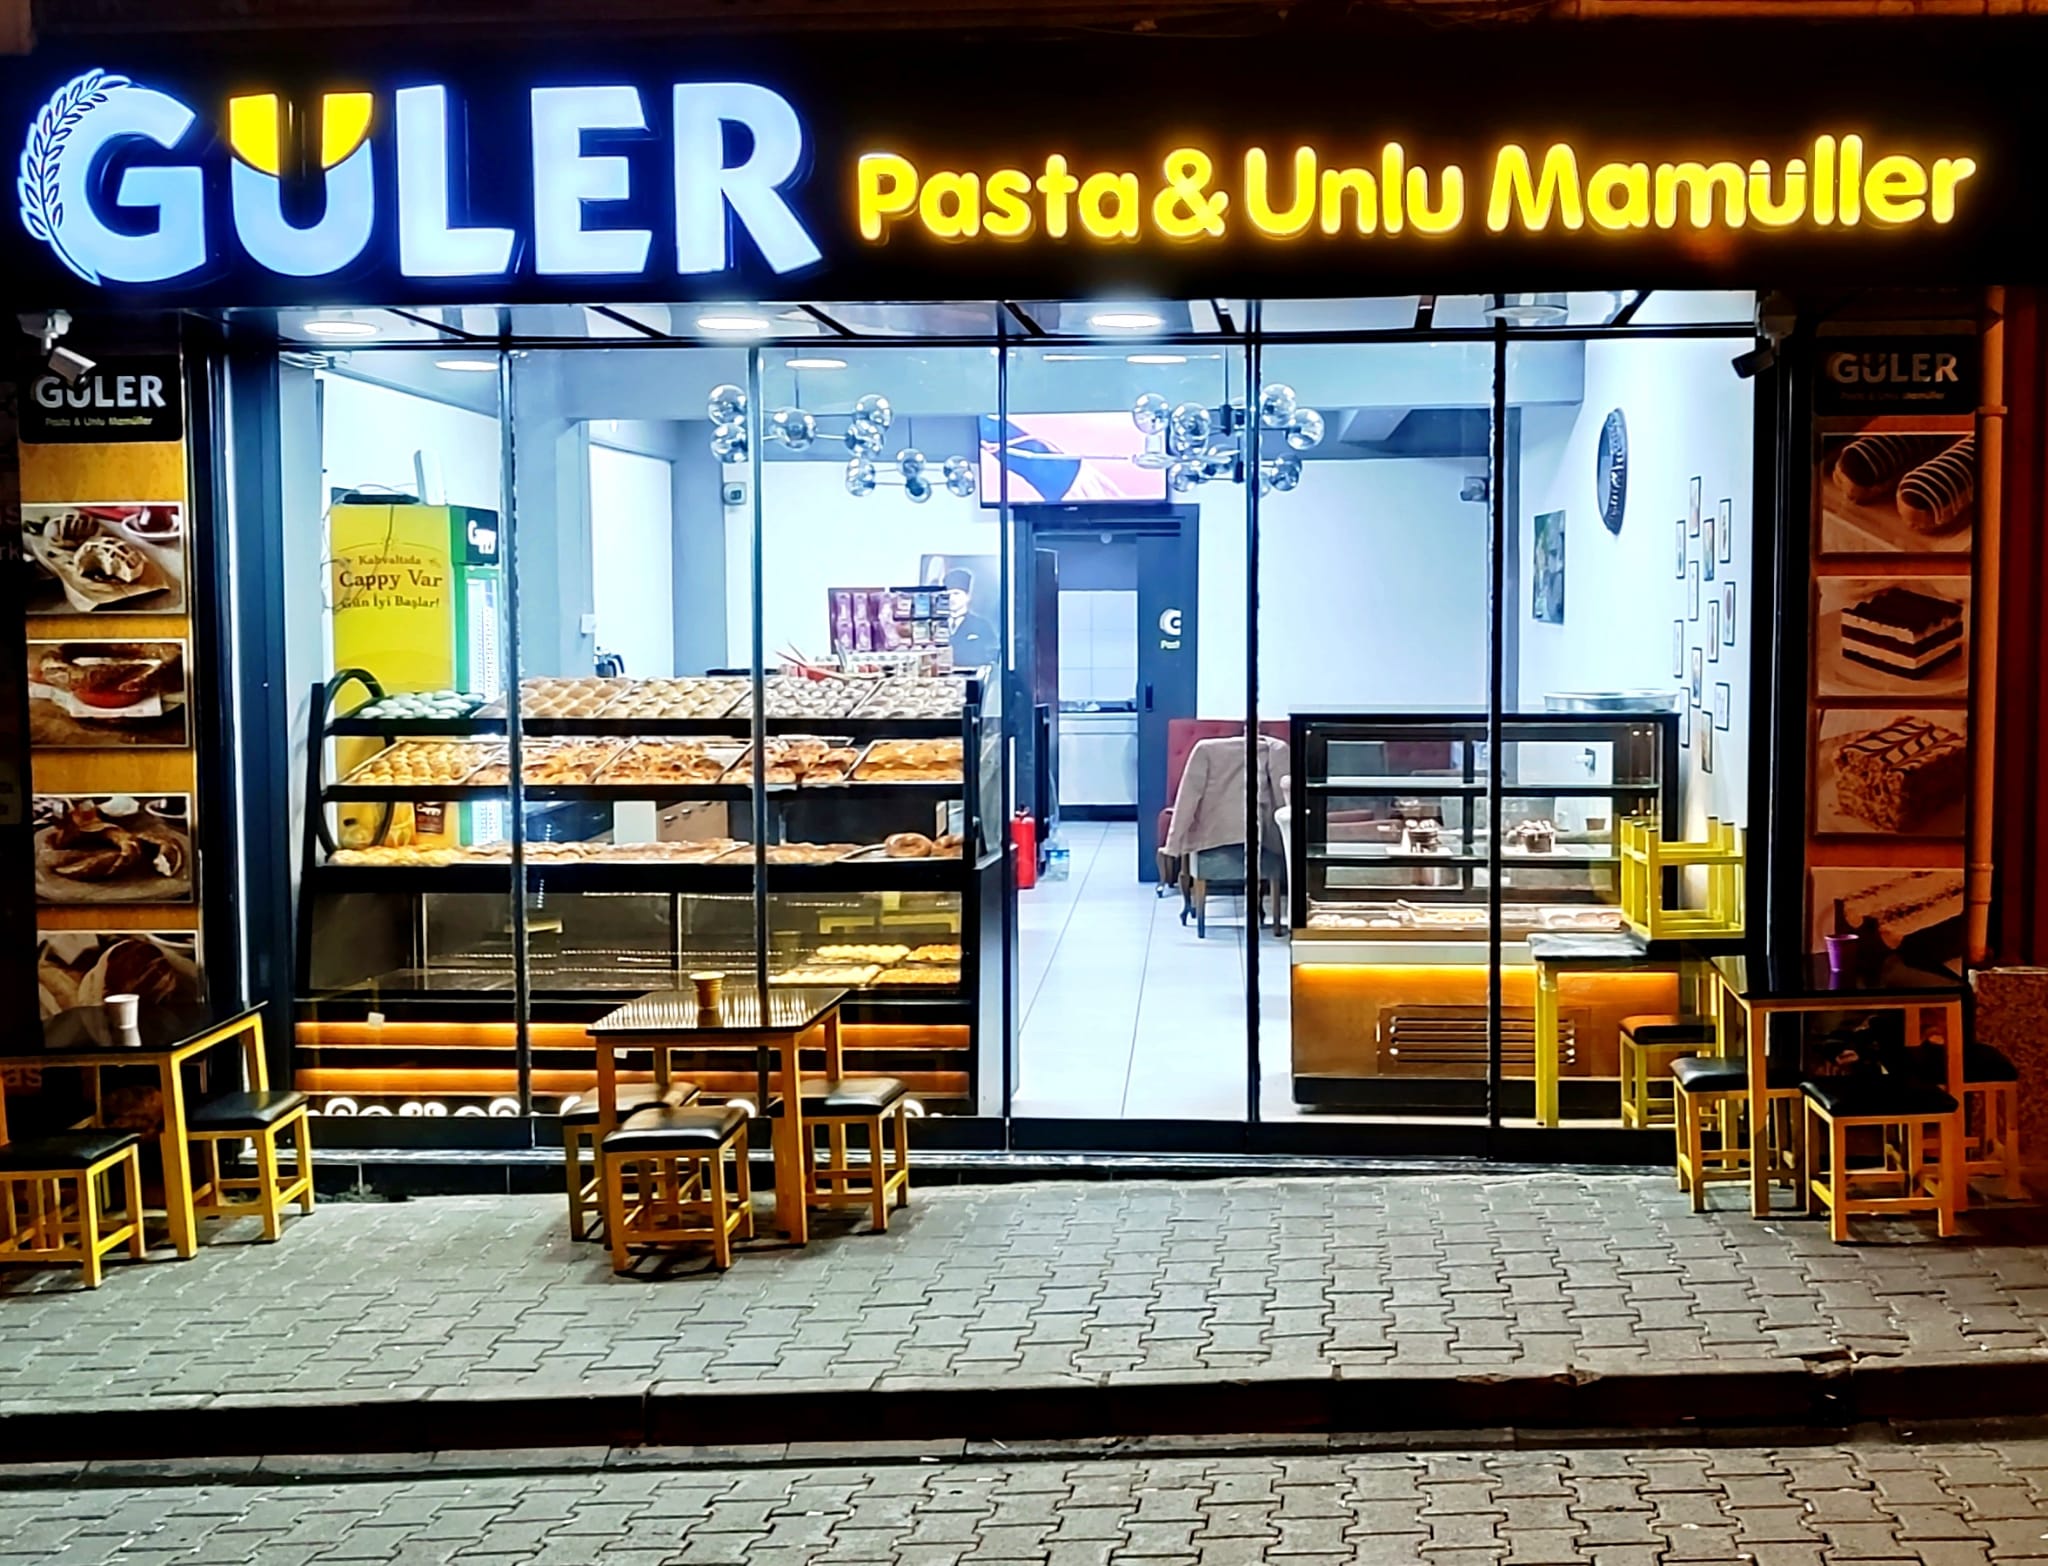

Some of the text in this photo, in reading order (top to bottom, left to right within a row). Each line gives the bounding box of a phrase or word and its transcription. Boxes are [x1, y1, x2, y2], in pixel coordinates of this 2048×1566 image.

[857, 152, 1140, 240] Pasta
[1153, 147, 1229, 238] &
[1243, 141, 1465, 236] Unlu
[339, 568, 443, 591] Cappy Var
